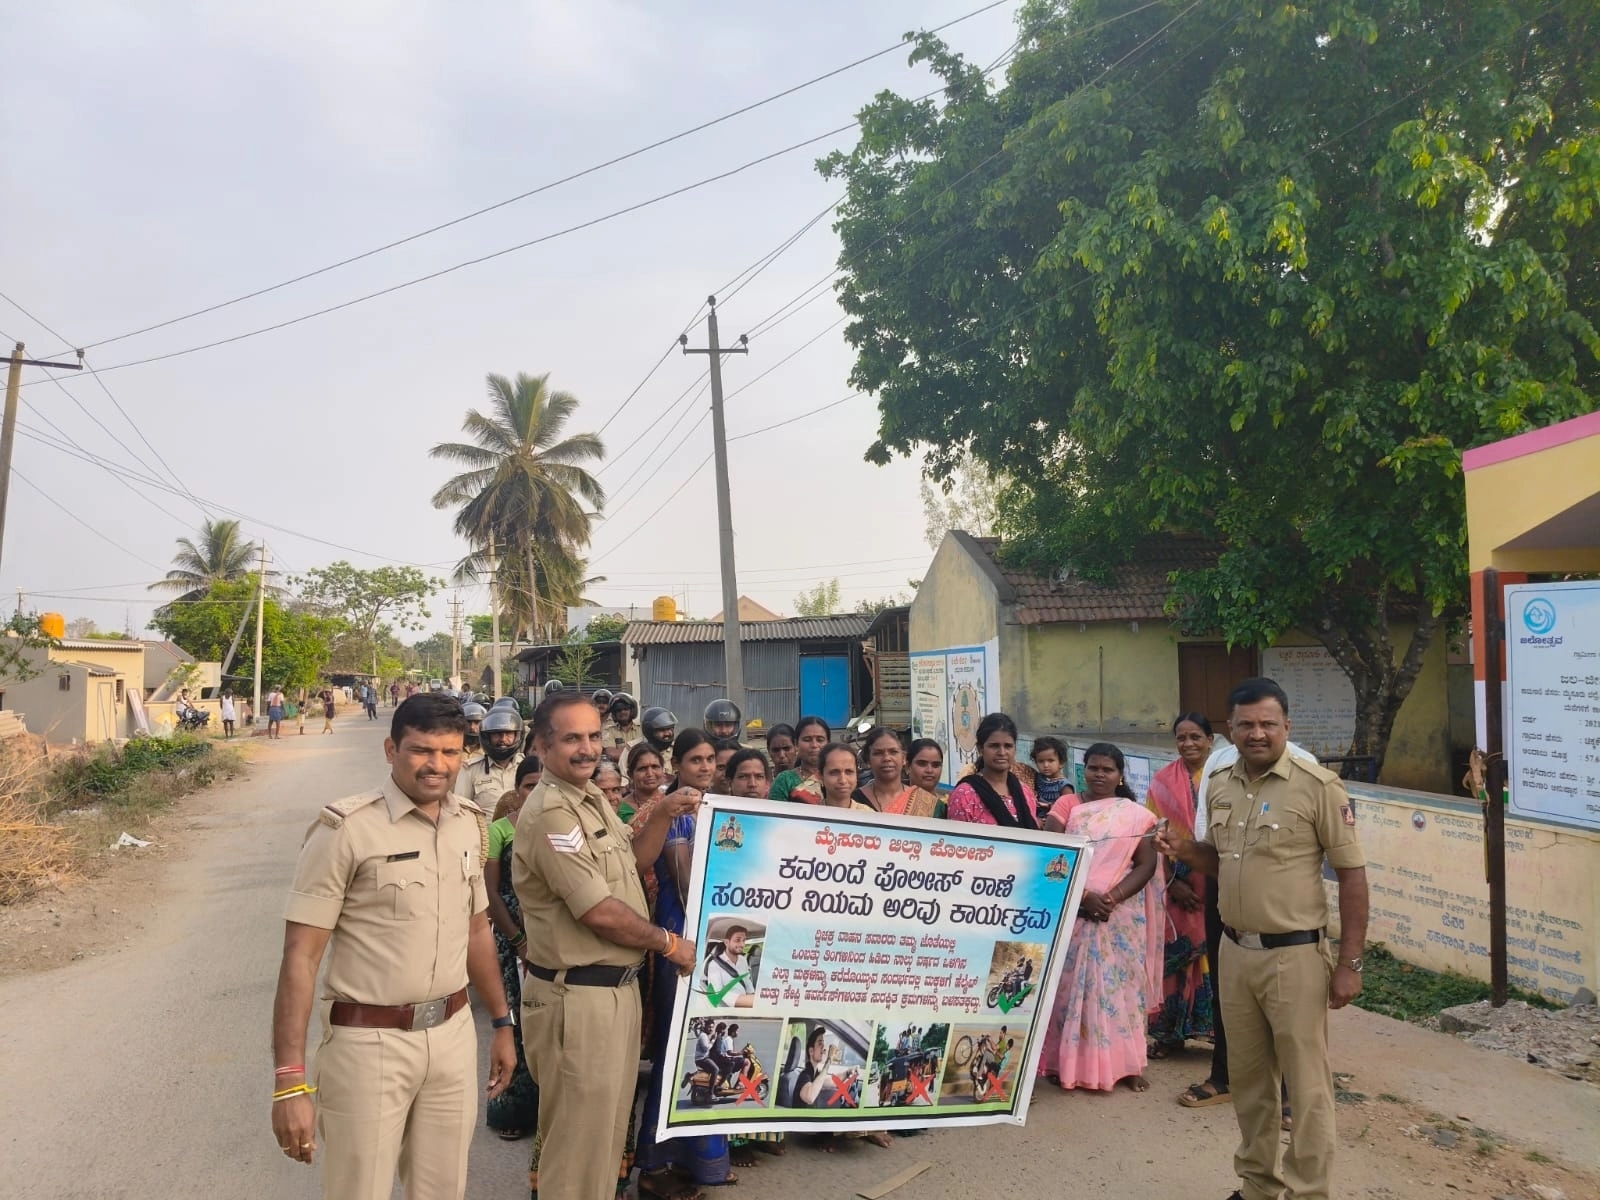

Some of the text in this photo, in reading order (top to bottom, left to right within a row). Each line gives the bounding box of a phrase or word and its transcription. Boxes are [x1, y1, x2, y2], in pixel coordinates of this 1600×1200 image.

[815, 826, 882, 855] ಮೈಸೂರು
[888, 832, 922, 862] ಜಿಲ್ಲಾ
[778, 854, 867, 885] ಕವಲಂದೆ
[970, 874, 1016, 898] ಠಾಣೆ
[711, 880, 1051, 934] ಸಂಚಾರ ನಿಯಮ ಅರಿವು ಕಾರ್ಯಕ್ರಮ
